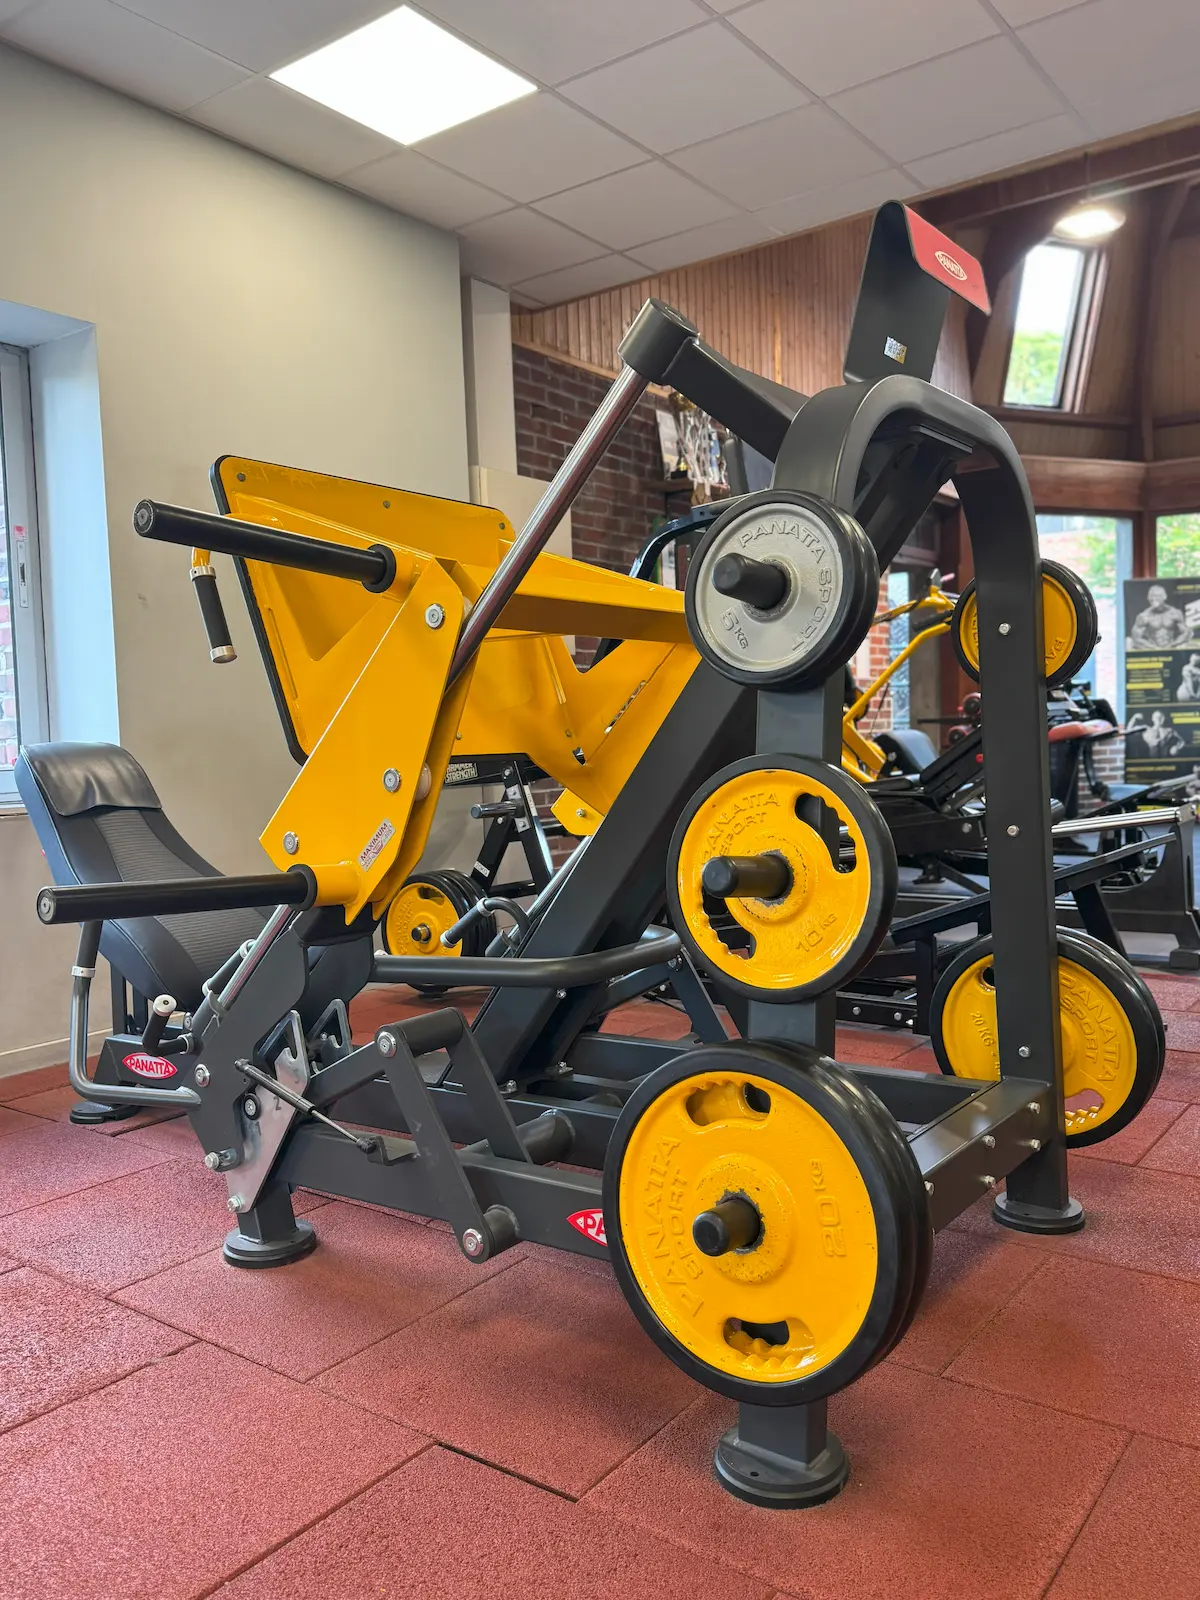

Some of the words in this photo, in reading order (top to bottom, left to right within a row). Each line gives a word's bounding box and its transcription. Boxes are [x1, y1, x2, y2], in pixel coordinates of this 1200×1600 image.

[720, 606, 740, 632] 5
[738, 519, 827, 565] PANATTA
[792, 566, 833, 654] SPORT
[360, 822, 388, 861] MAXIMUM
[1059, 971, 1122, 1083] PANATTA
[1060, 994, 1098, 1065] SPORT
[129, 1057, 172, 1075] PANATTA
[273, 1097, 283, 1111] 2
[644, 1134, 704, 1318] PANATTA
[668, 1166, 704, 1281] SPORT
